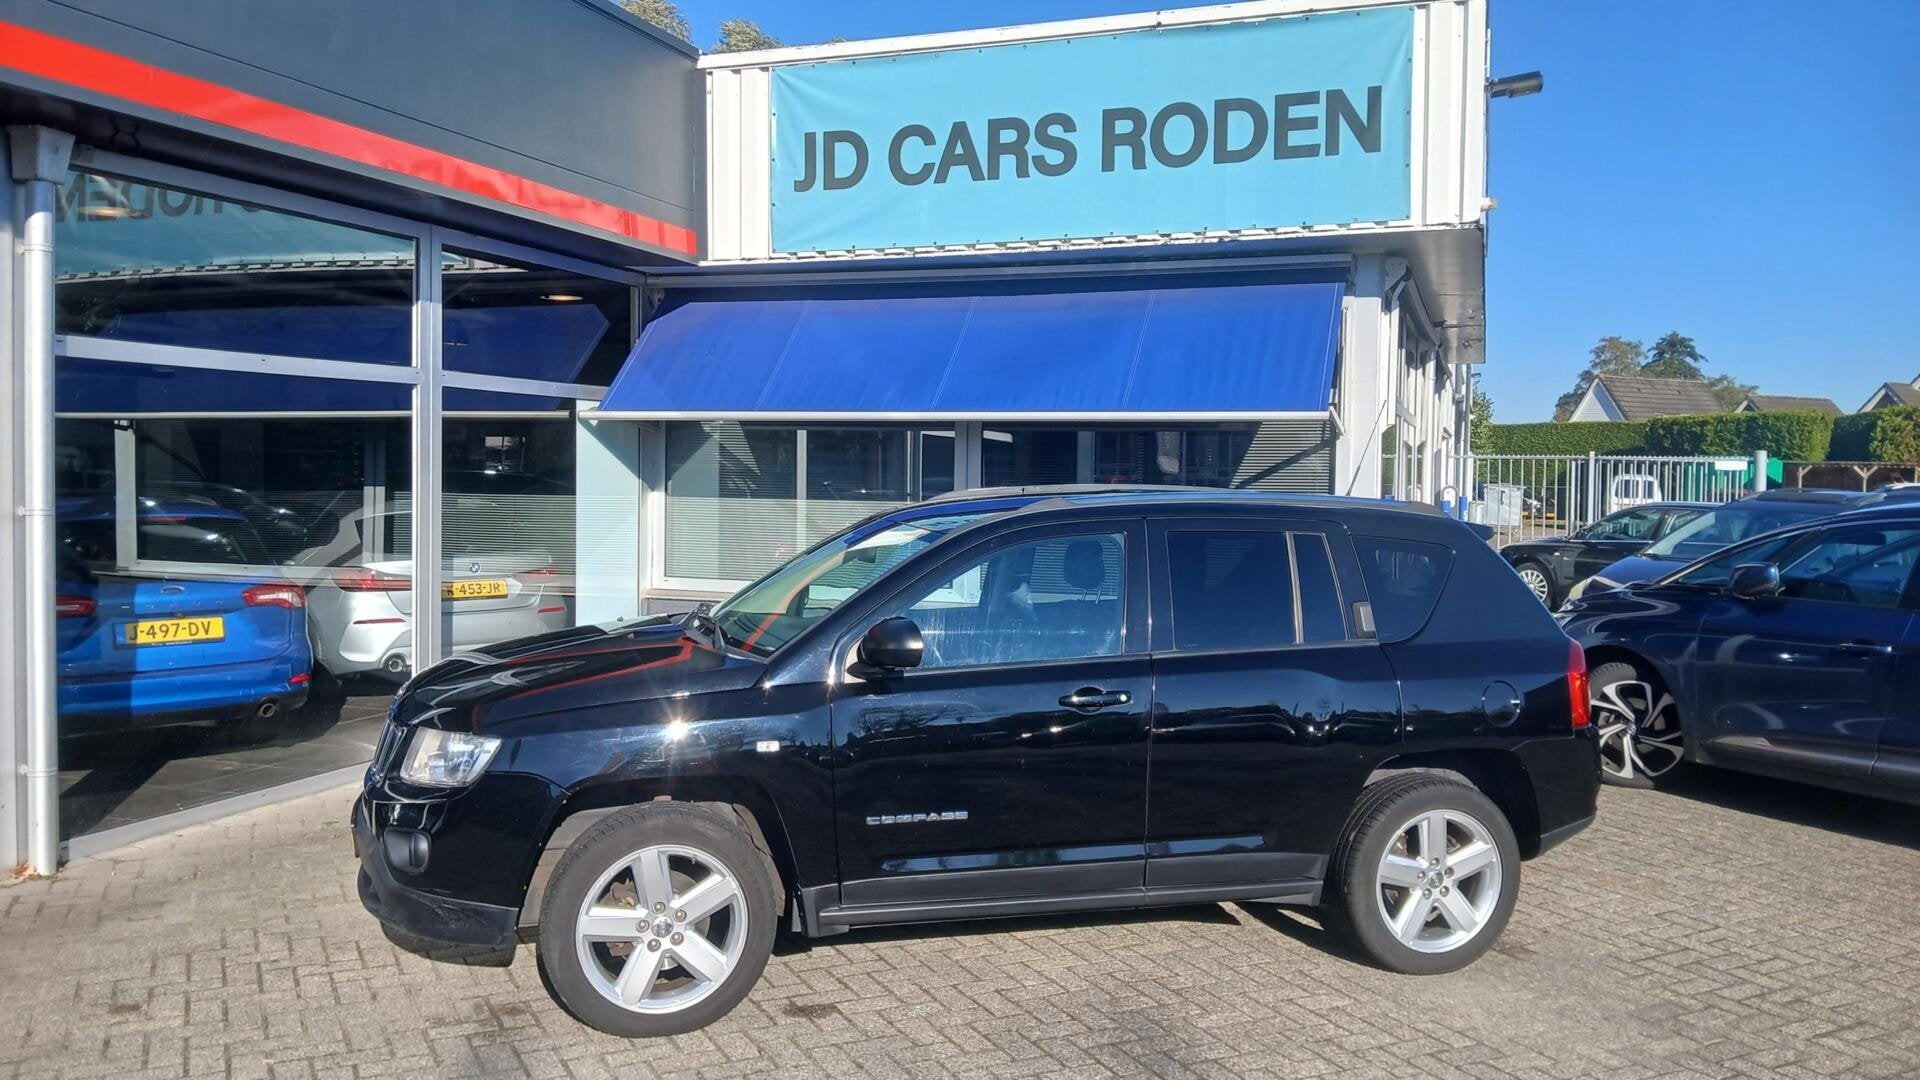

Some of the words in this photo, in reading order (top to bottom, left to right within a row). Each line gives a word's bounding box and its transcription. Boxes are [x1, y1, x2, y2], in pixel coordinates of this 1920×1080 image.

[794, 130, 868, 193] JD
[887, 112, 1078, 186] CARS
[1101, 85, 1383, 173] RODEN
[129, 620, 212, 641] J-497-DV
